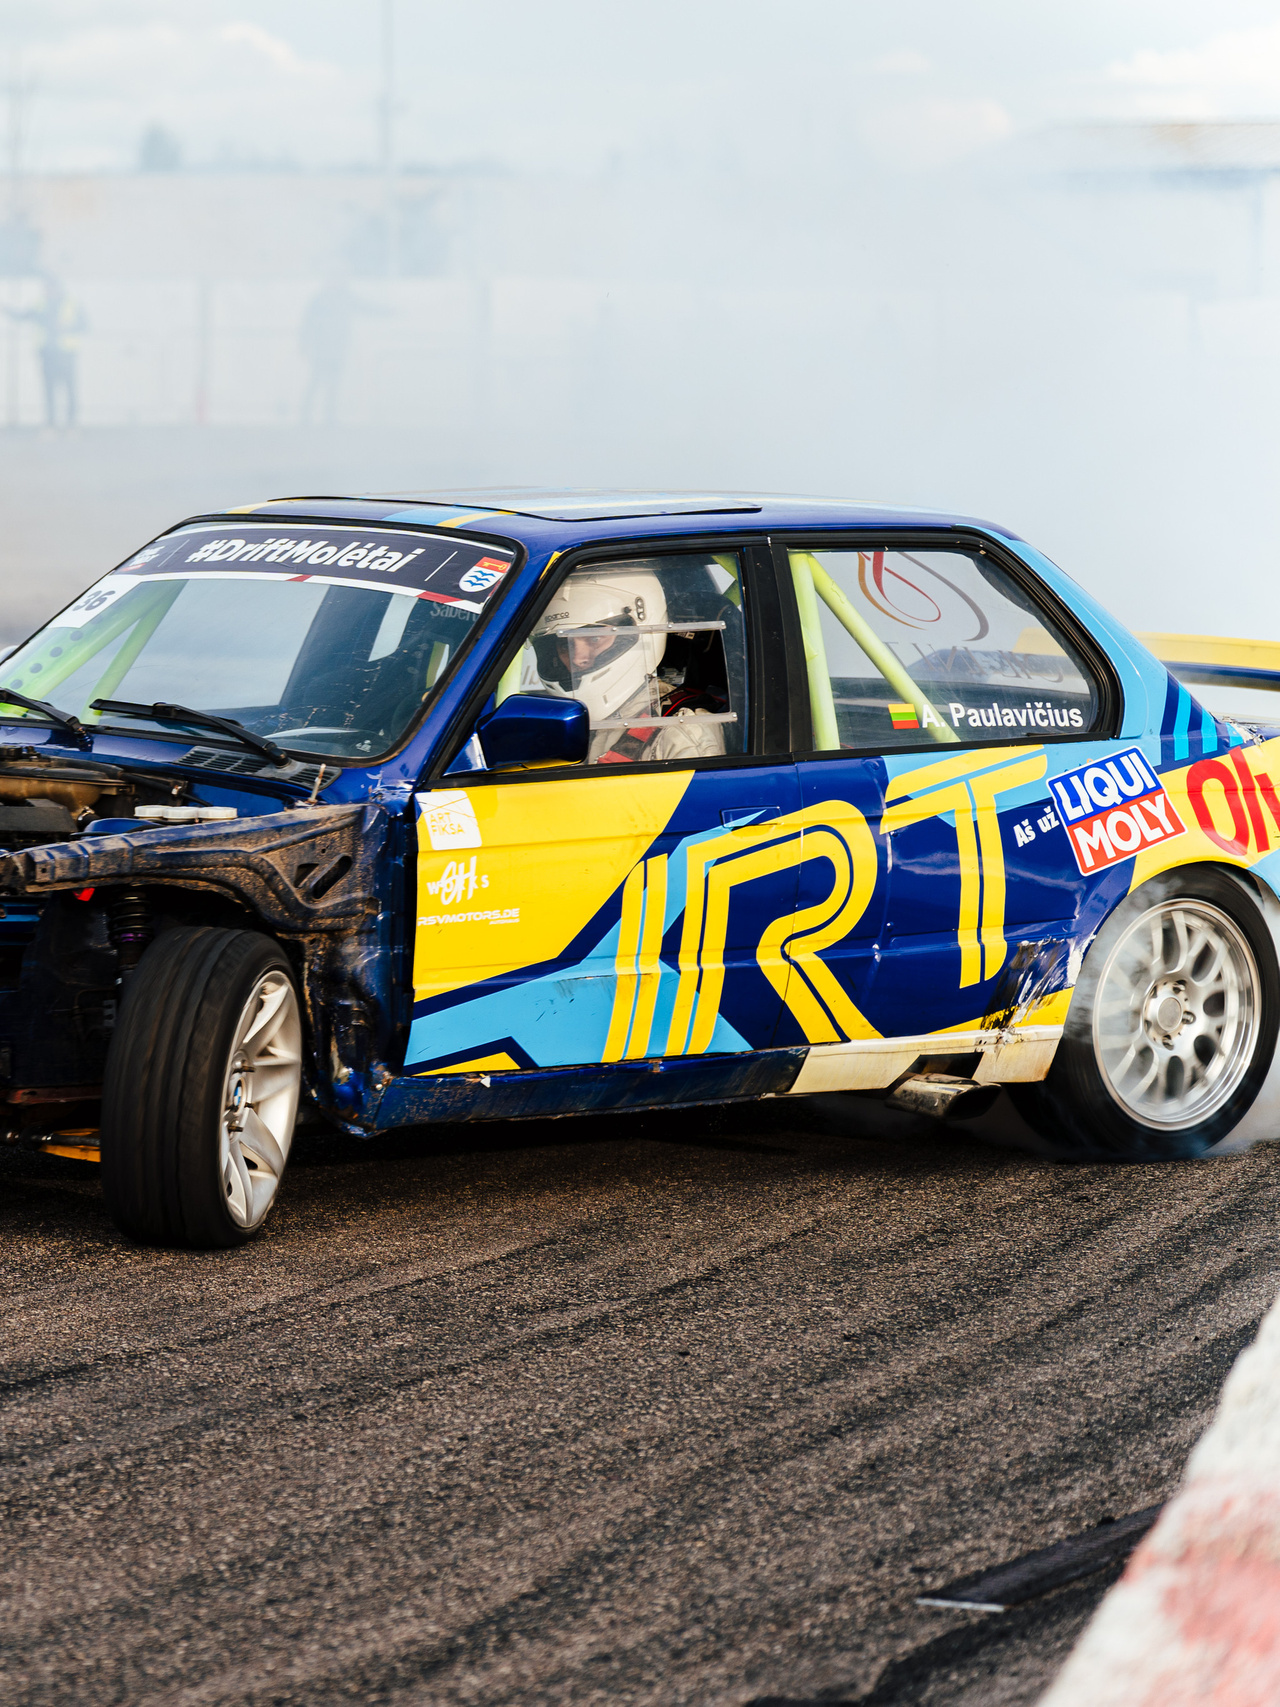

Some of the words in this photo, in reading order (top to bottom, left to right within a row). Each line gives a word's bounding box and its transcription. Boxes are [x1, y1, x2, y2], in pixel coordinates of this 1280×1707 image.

[184, 538, 426, 573] #DriftMolėtai
[72, 590, 116, 611] 36
[921, 705, 946, 728] A.
[949, 702, 1084, 728] Paulavičius
[1053, 751, 1157, 822] LIQUI
[428, 811, 452, 824] ART
[430, 823, 466, 837] FIKSA
[1013, 818, 1036, 848] Aš
[1036, 805, 1060, 834] už
[1073, 793, 1176, 868] MOLY
[417, 907, 520, 926] RSVMOTORS.DE
